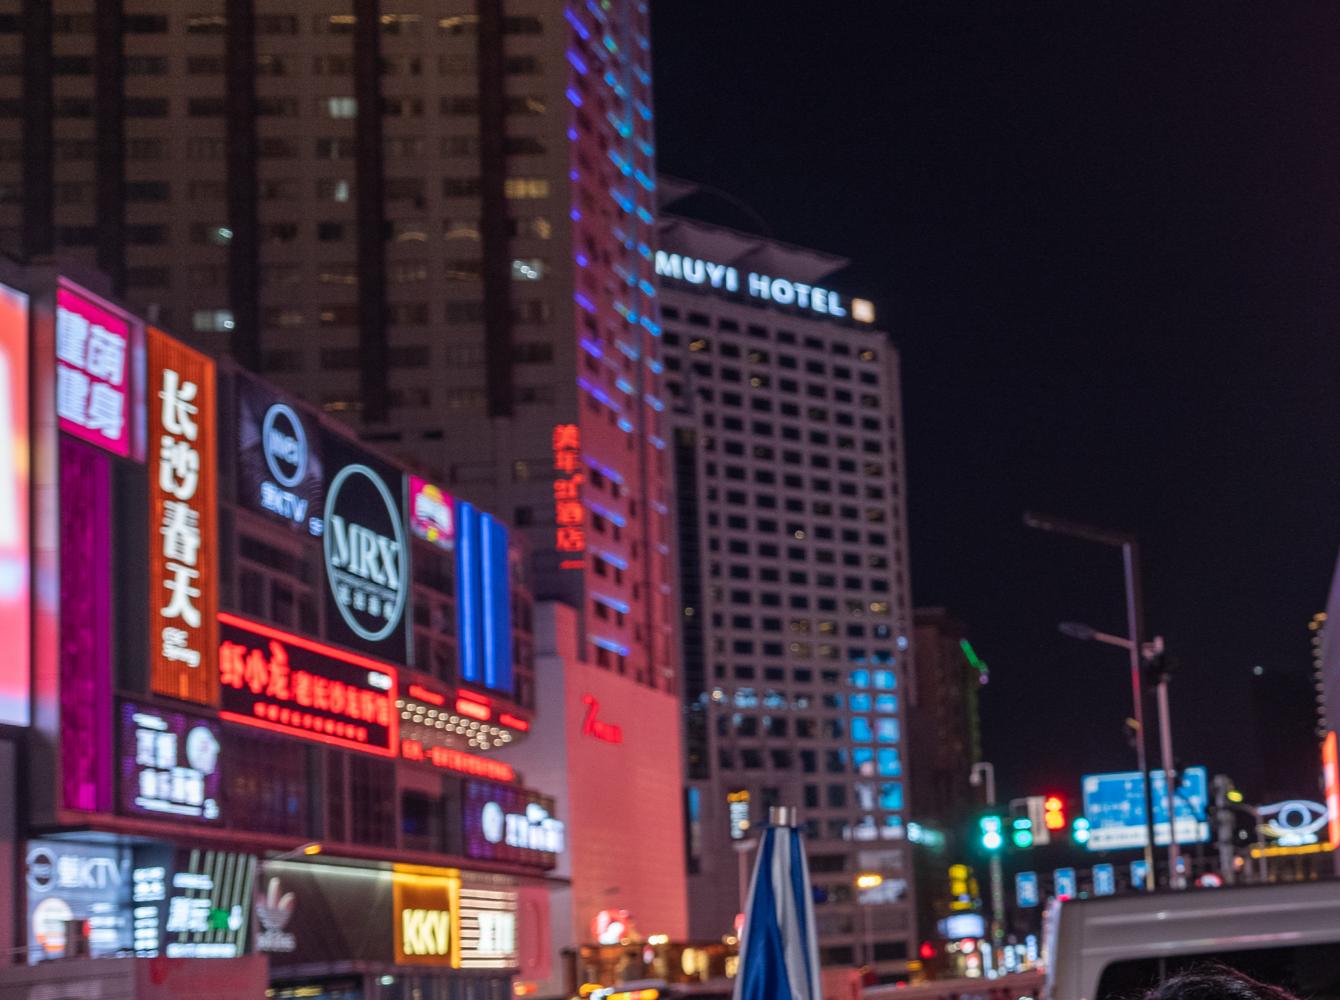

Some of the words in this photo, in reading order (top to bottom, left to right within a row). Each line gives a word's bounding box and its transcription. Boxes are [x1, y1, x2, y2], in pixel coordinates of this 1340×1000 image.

[655, 250, 738, 292] MUYI
[748, 272, 847, 317] HOTEL
[158, 368, 204, 628] 长沙春天
[330, 515, 400, 590] MRX
[402, 908, 450, 956] KKV
